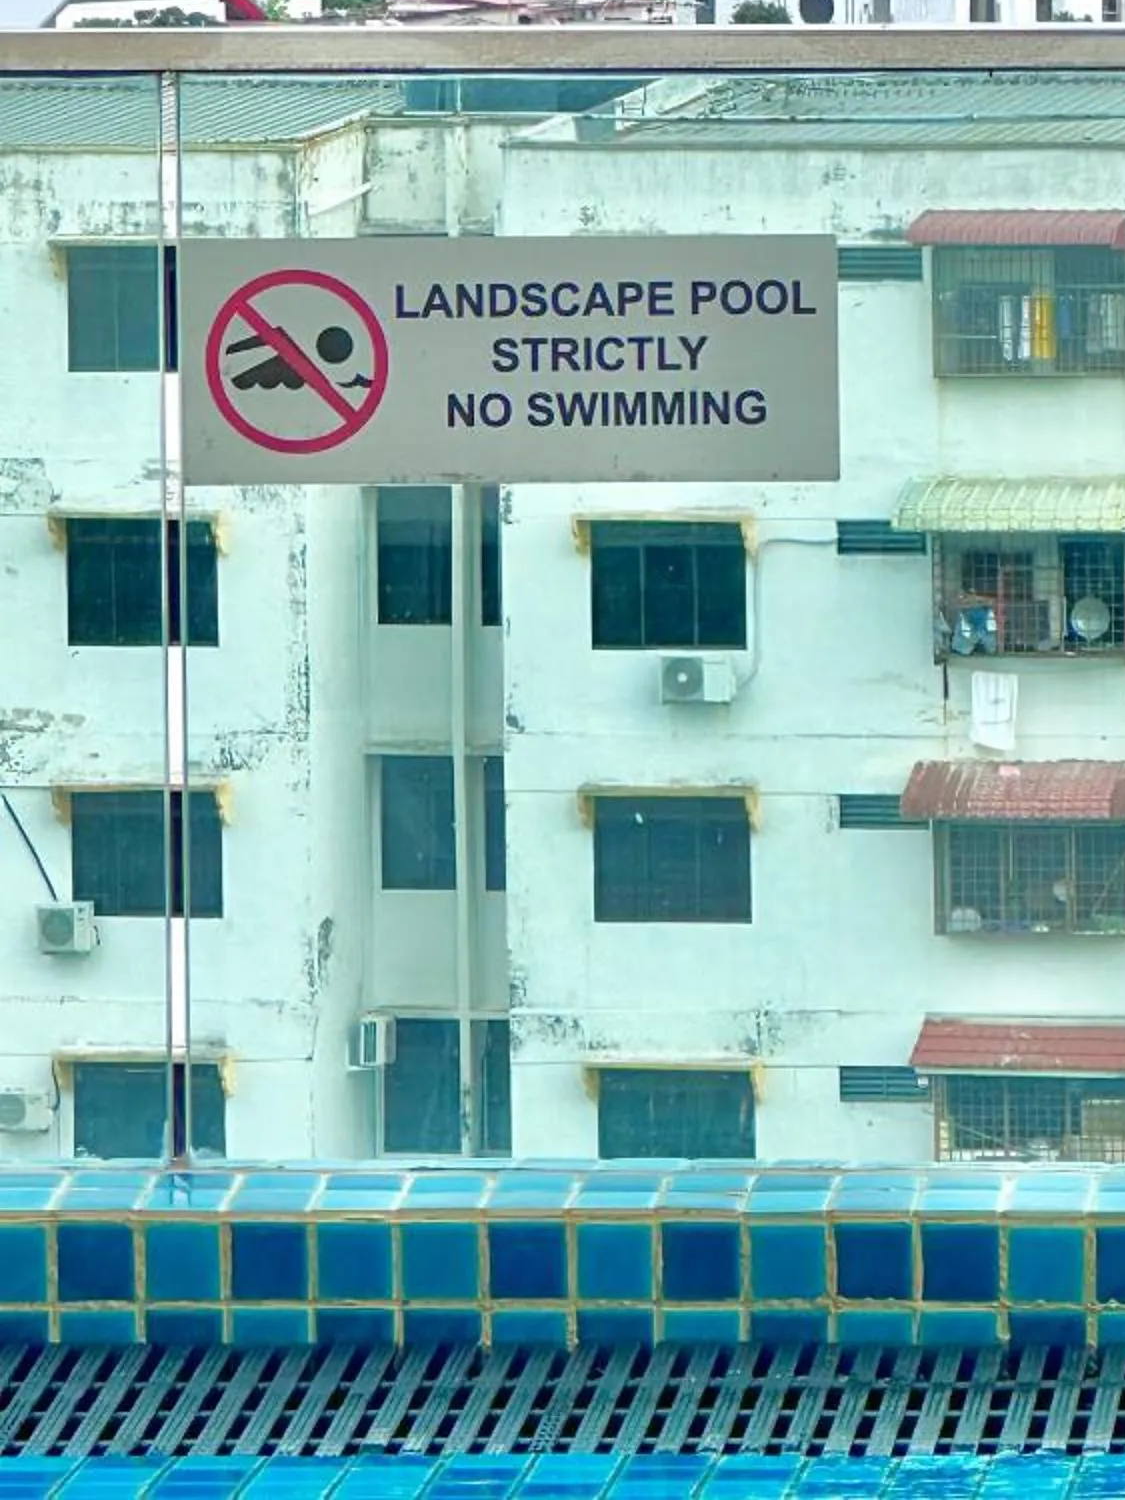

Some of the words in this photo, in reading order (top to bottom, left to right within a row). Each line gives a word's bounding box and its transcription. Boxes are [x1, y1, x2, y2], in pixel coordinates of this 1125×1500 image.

[394, 281, 674, 318] LANDSCAPE
[691, 280, 817, 315] POOL
[491, 336, 709, 373] STRICTLY
[447, 392, 513, 427] NO
[527, 389, 767, 427] SWIMMING
